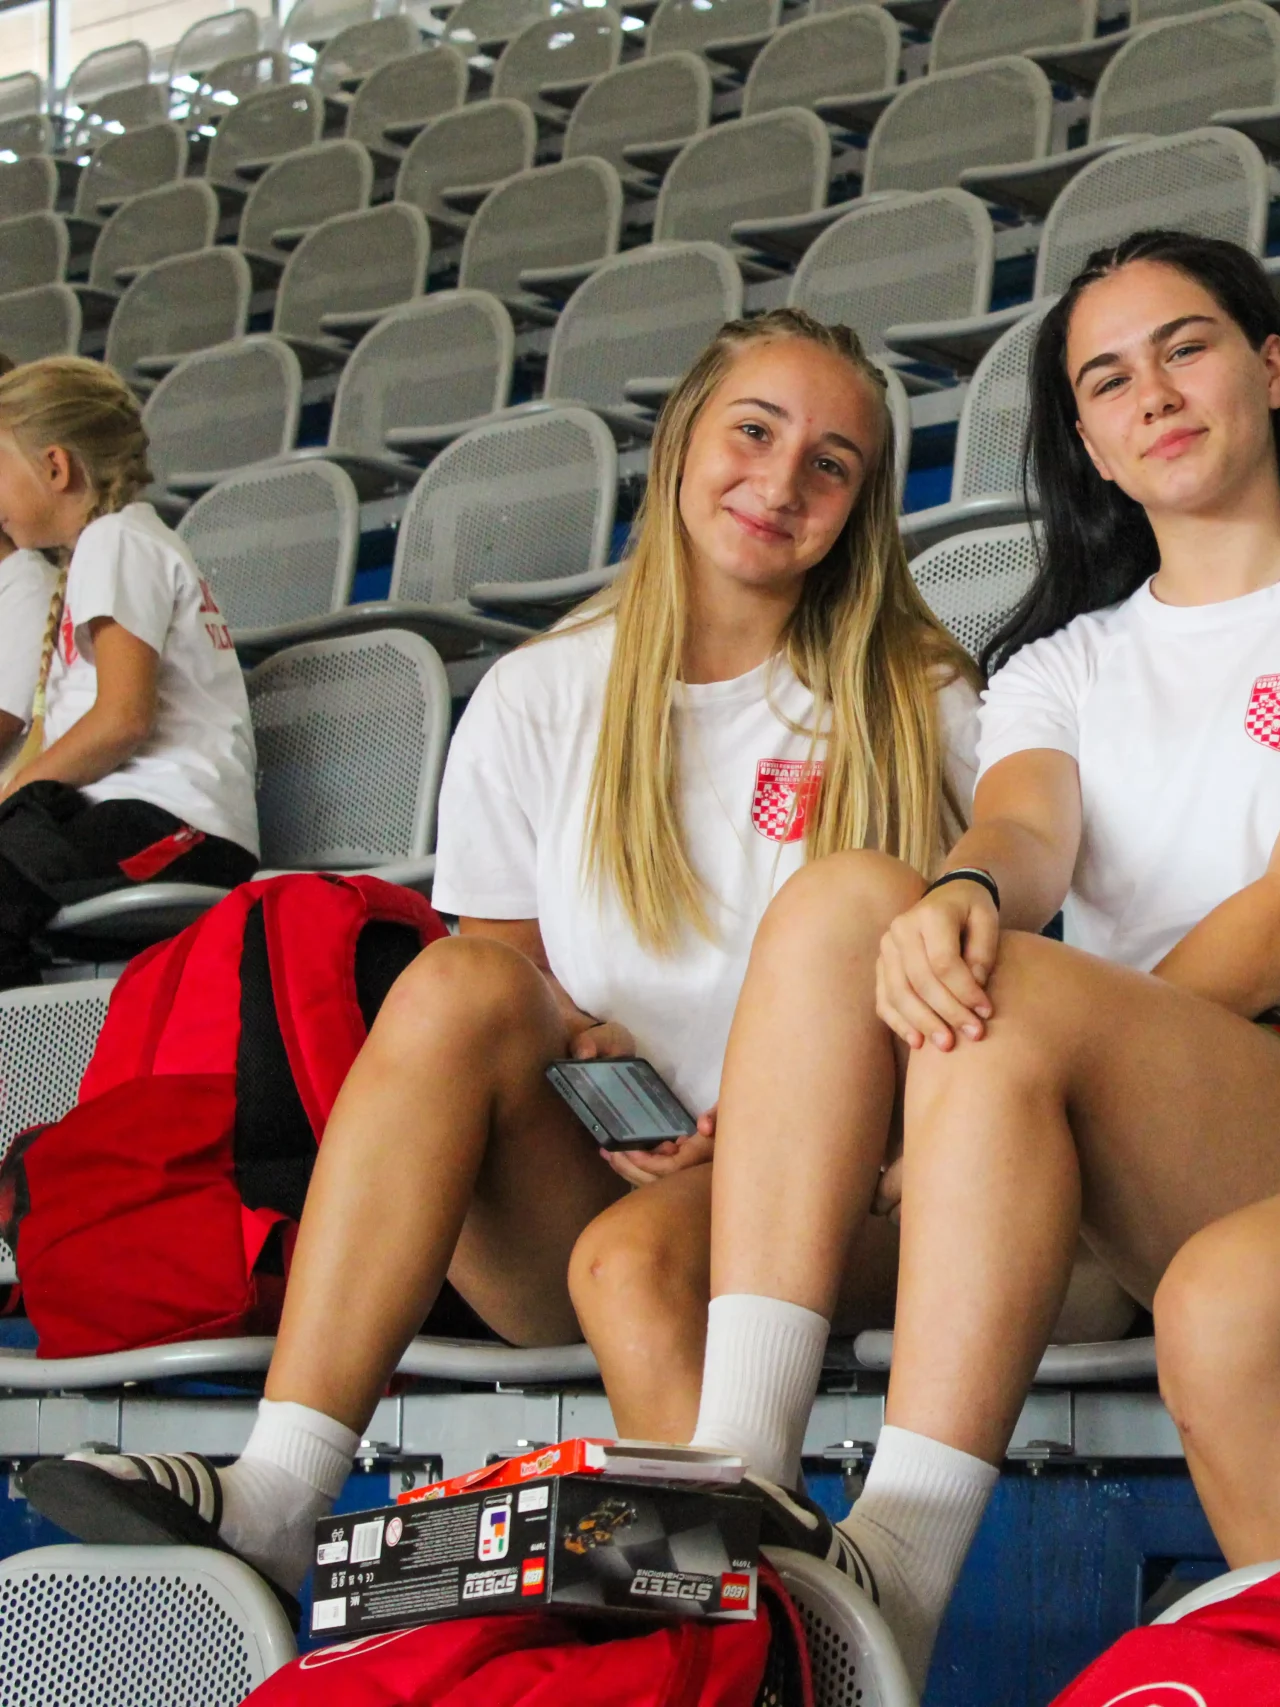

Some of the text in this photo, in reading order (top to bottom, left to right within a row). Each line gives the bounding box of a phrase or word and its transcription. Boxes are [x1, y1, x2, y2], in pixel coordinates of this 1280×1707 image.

[462, 1574, 518, 1599] SPEED
[636, 1568, 685, 1581] CHAMPIONS
[630, 1576, 748, 1601] SPEED LEGO
